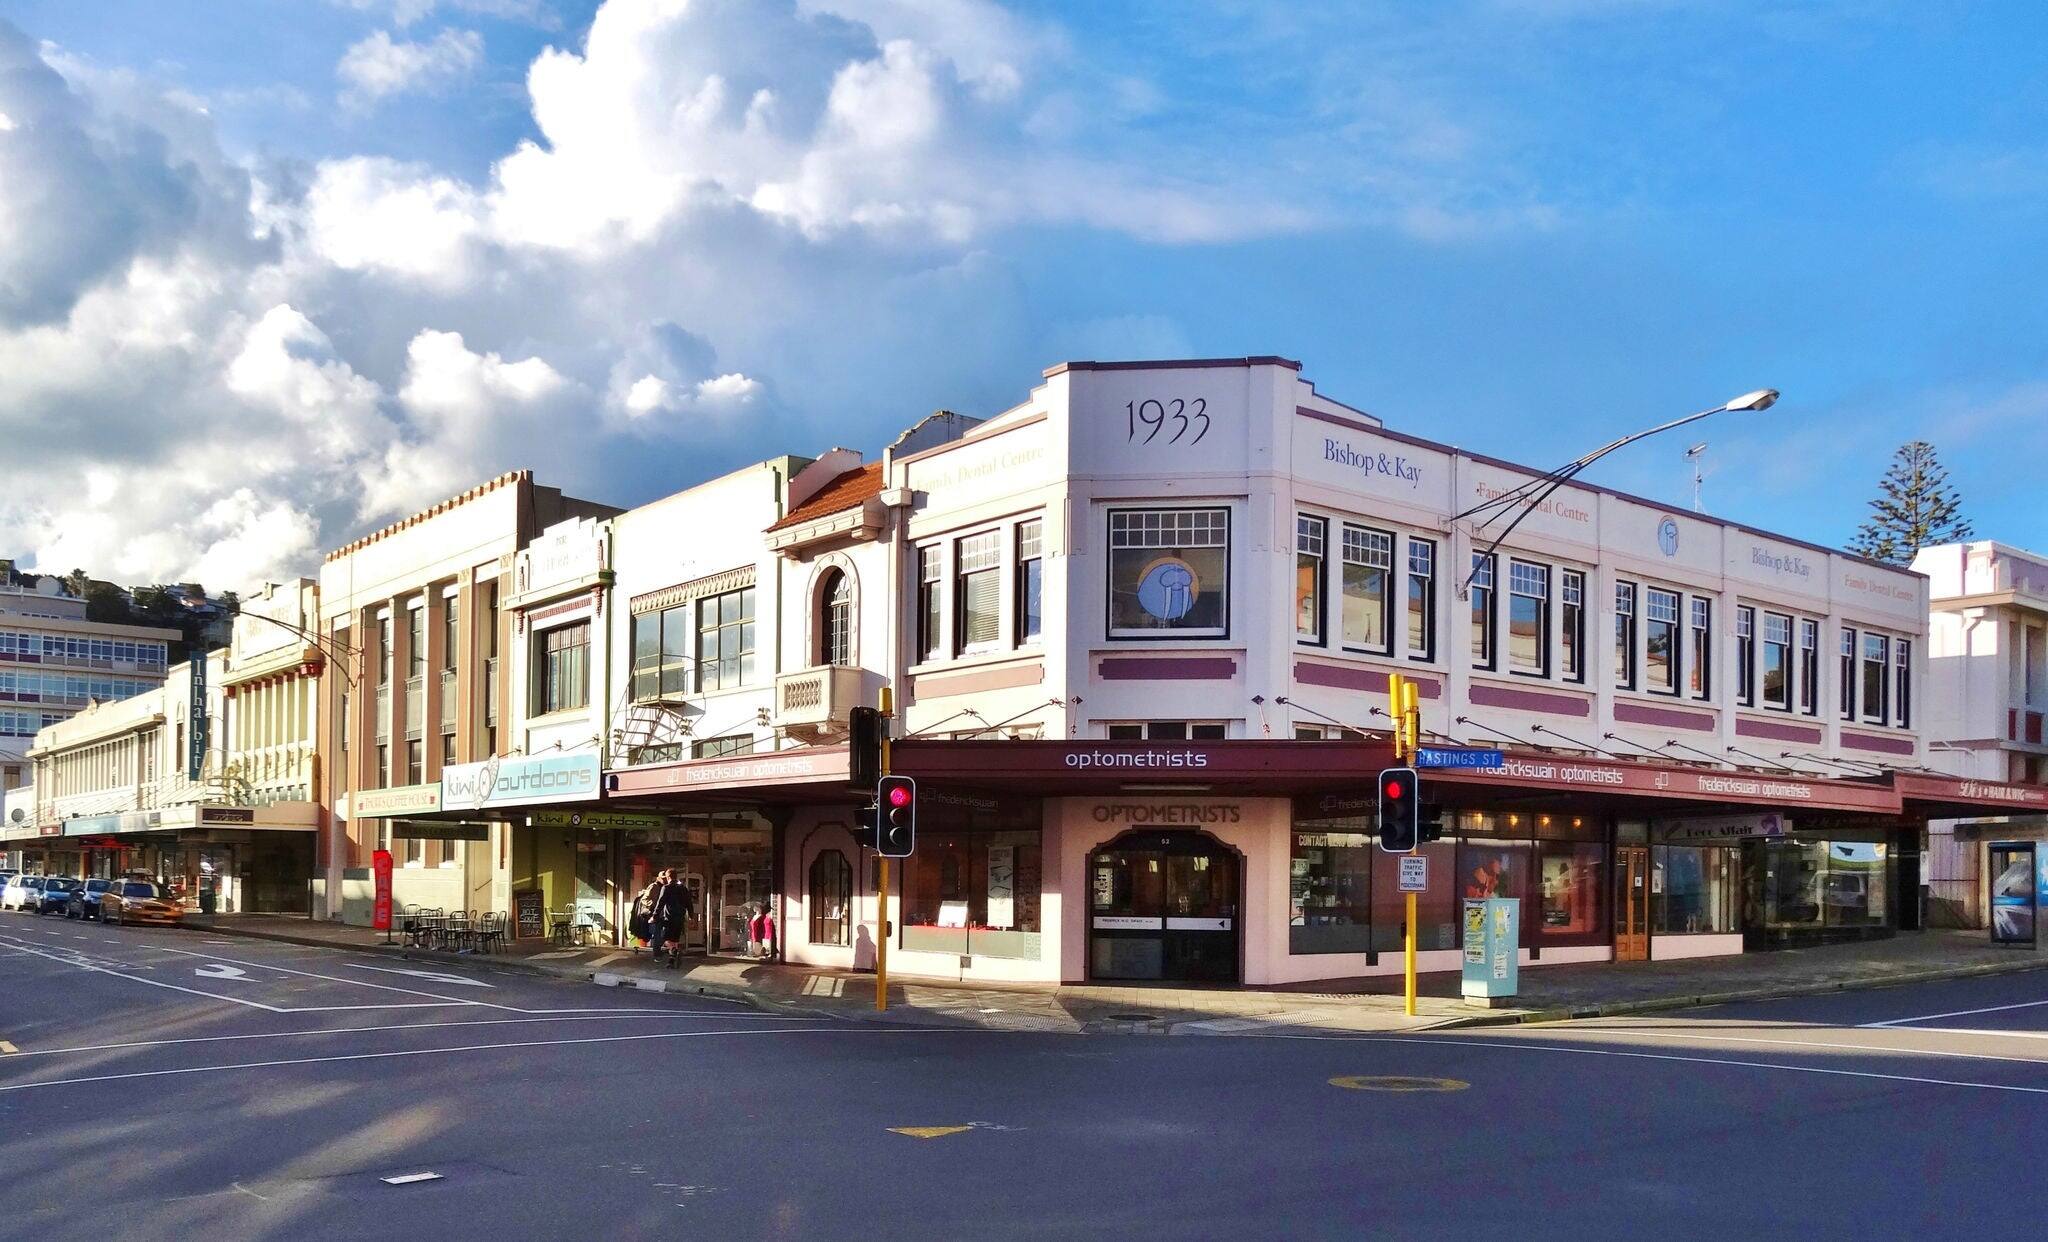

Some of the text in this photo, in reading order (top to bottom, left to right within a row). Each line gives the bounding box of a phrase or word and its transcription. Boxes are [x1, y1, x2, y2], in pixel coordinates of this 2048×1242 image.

[1126, 398, 1210, 446] 1933
[958, 458, 997, 482] Dental
[1001, 447, 1044, 469] Centre
[1324, 439, 1422, 489] Bishop & Kay
[1555, 502, 1589, 522] Centre
[1752, 547, 1812, 582] Bishop & Kay
[193, 659, 204, 770] Inhabit
[1065, 750, 1207, 770] optometrists
[1419, 752, 1497, 766] HASTINGS ST
[448, 764, 591, 796] kiwi outdoors
[686, 760, 813, 782] frederickswain optometrists
[1560, 766, 1623, 785] optometrists
[1698, 776, 1811, 799] frederickswain optometrists
[537, 813, 563, 823] kiwi
[587, 815, 660, 827] outdoors
[1092, 804, 1241, 823] OPTOMETRISTS
[1298, 834, 1328, 847] CONTACT
